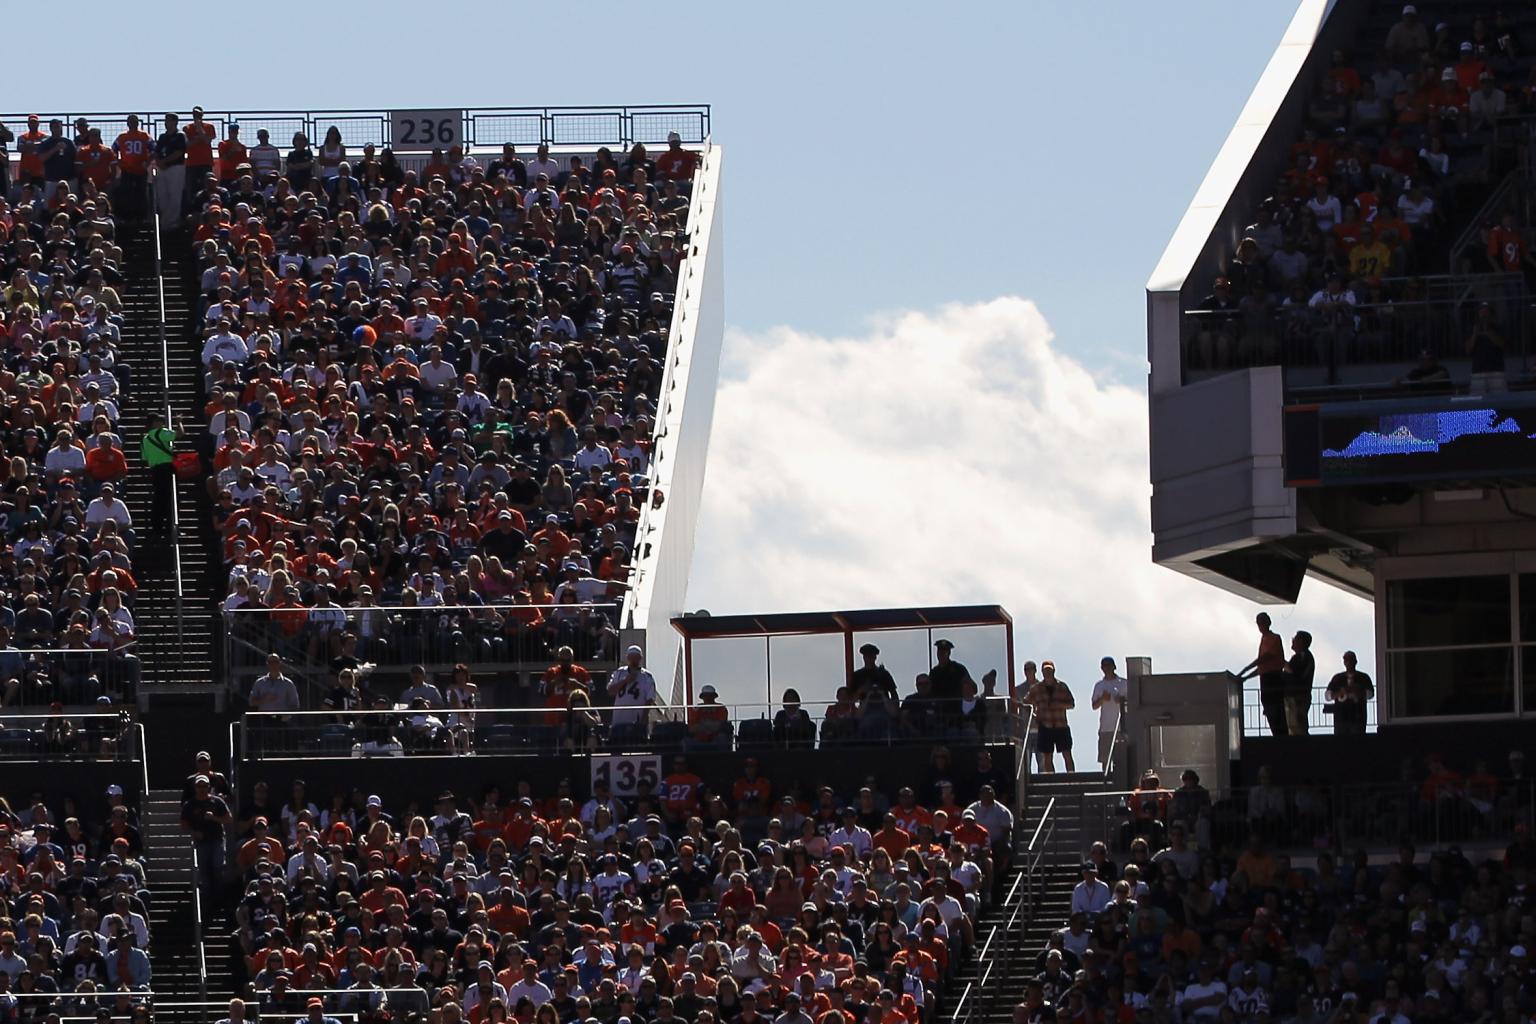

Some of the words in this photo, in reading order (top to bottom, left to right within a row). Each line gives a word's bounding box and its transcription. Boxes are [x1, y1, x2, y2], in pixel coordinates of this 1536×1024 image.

[399, 118, 455, 145] 236
[124, 140, 143, 154] 30
[596, 761, 658, 792] 135
[669, 784, 691, 800] 27
[72, 843, 86, 857] 19
